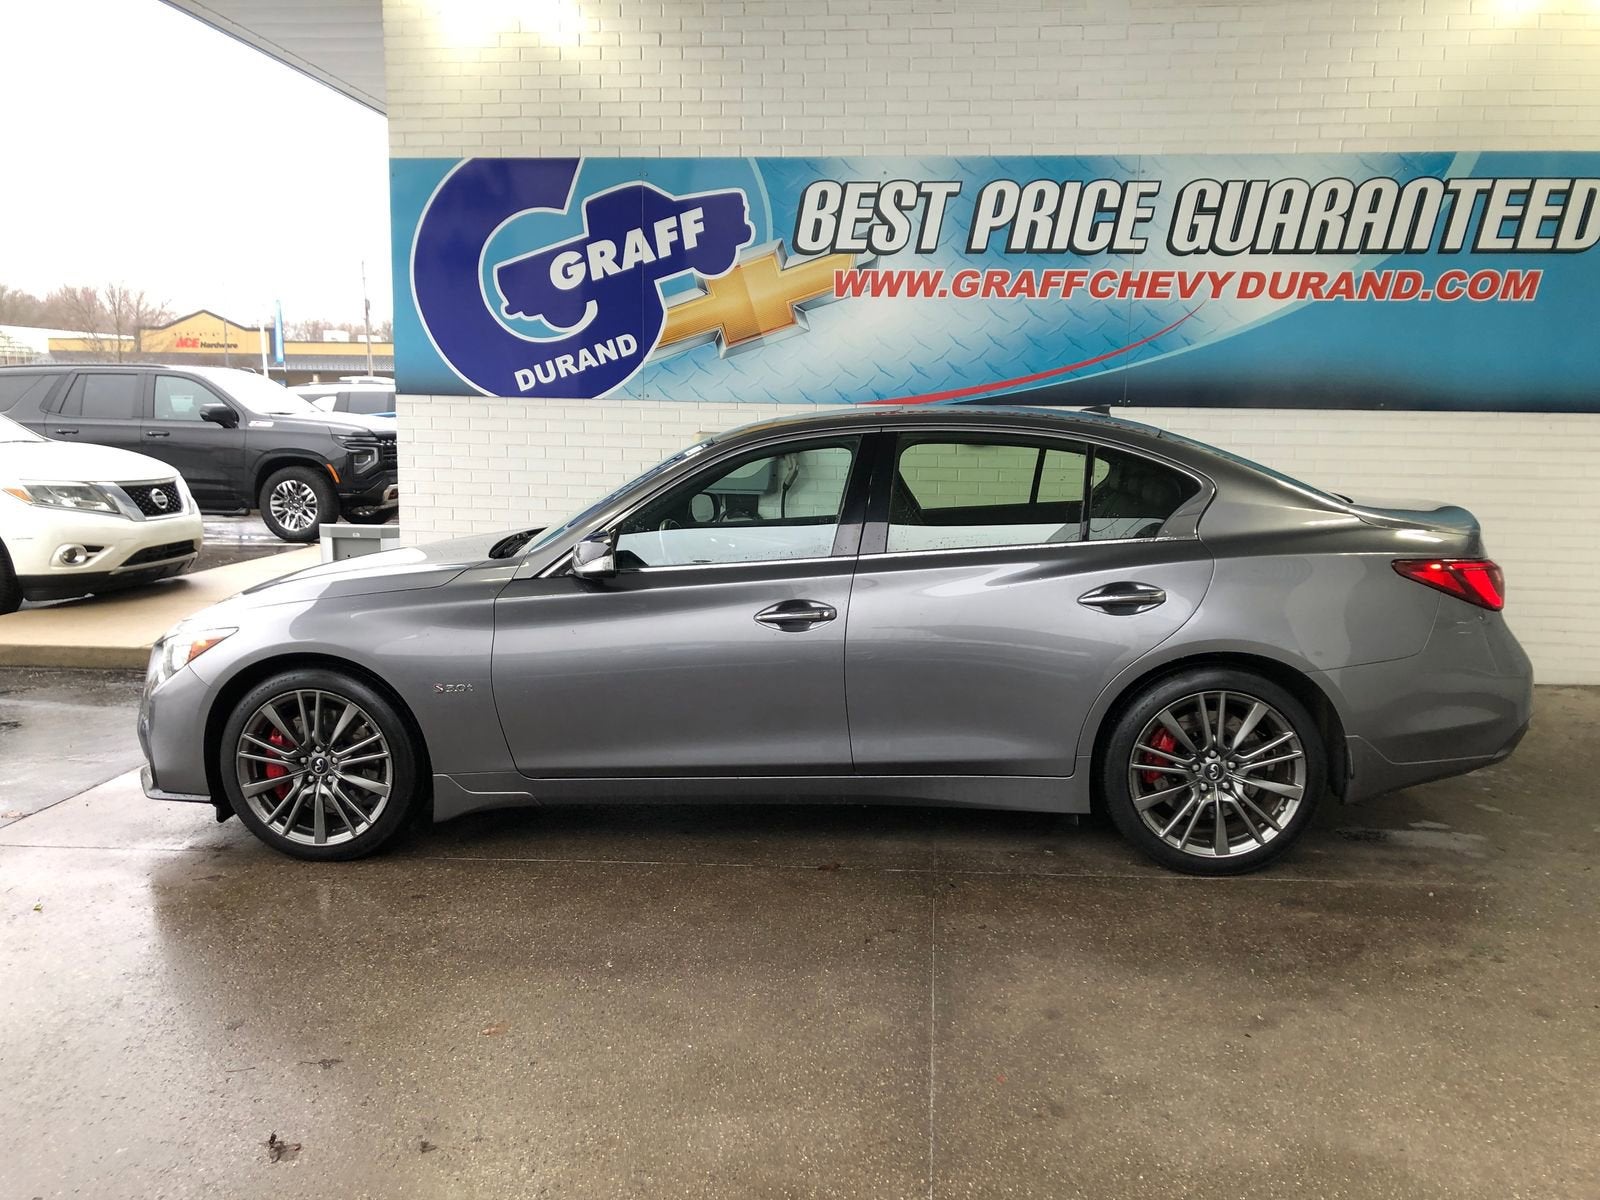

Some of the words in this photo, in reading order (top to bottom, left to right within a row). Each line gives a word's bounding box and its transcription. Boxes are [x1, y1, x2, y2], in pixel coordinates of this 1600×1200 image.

[793, 179, 962, 255] BEST
[966, 178, 1161, 255] PRICE
[1166, 176, 1600, 256] GUARANTEED
[549, 206, 705, 291] GRAFF
[834, 268, 1543, 301] WWW.GRAFFCHEVYDURAND.COM
[175, 336, 199, 348] ACE
[513, 333, 638, 392] DURAND
